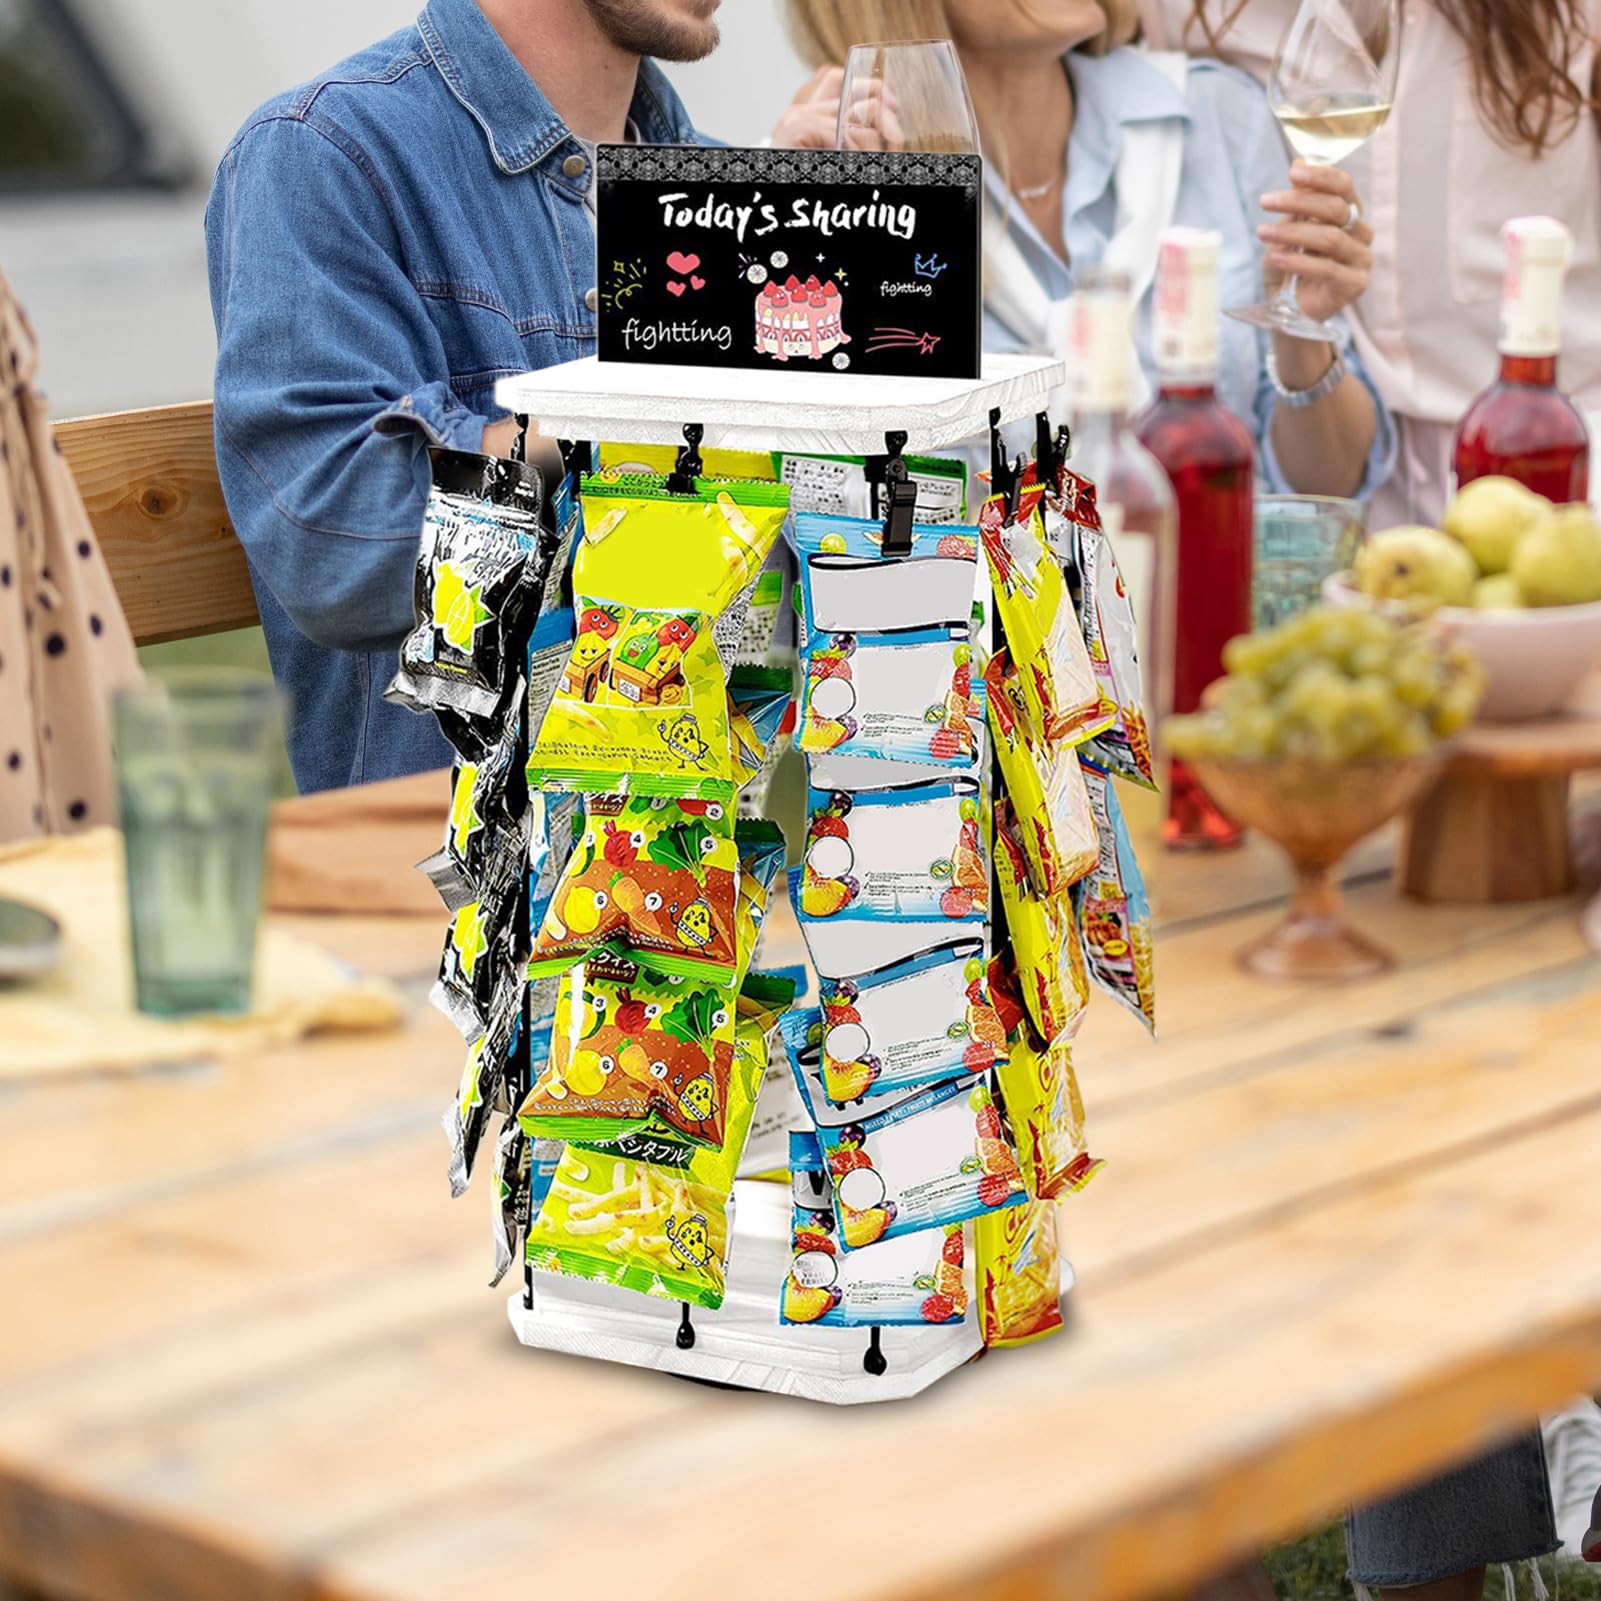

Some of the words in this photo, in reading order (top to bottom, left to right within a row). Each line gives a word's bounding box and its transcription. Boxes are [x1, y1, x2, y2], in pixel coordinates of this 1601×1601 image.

[659, 192, 778, 242] Today's
[784, 190, 915, 239] Sharing
[622, 318, 731, 350] fightting
[633, 833, 643, 844] 4
[704, 839, 714, 850] 5
[649, 897, 659, 906] 7
[595, 997, 605, 1008] 3
[648, 1005, 657, 1015] 4
[715, 1014, 725, 1024] 5
[602, 1060, 610, 1070] 6
[654, 1065, 664, 1075] 7
